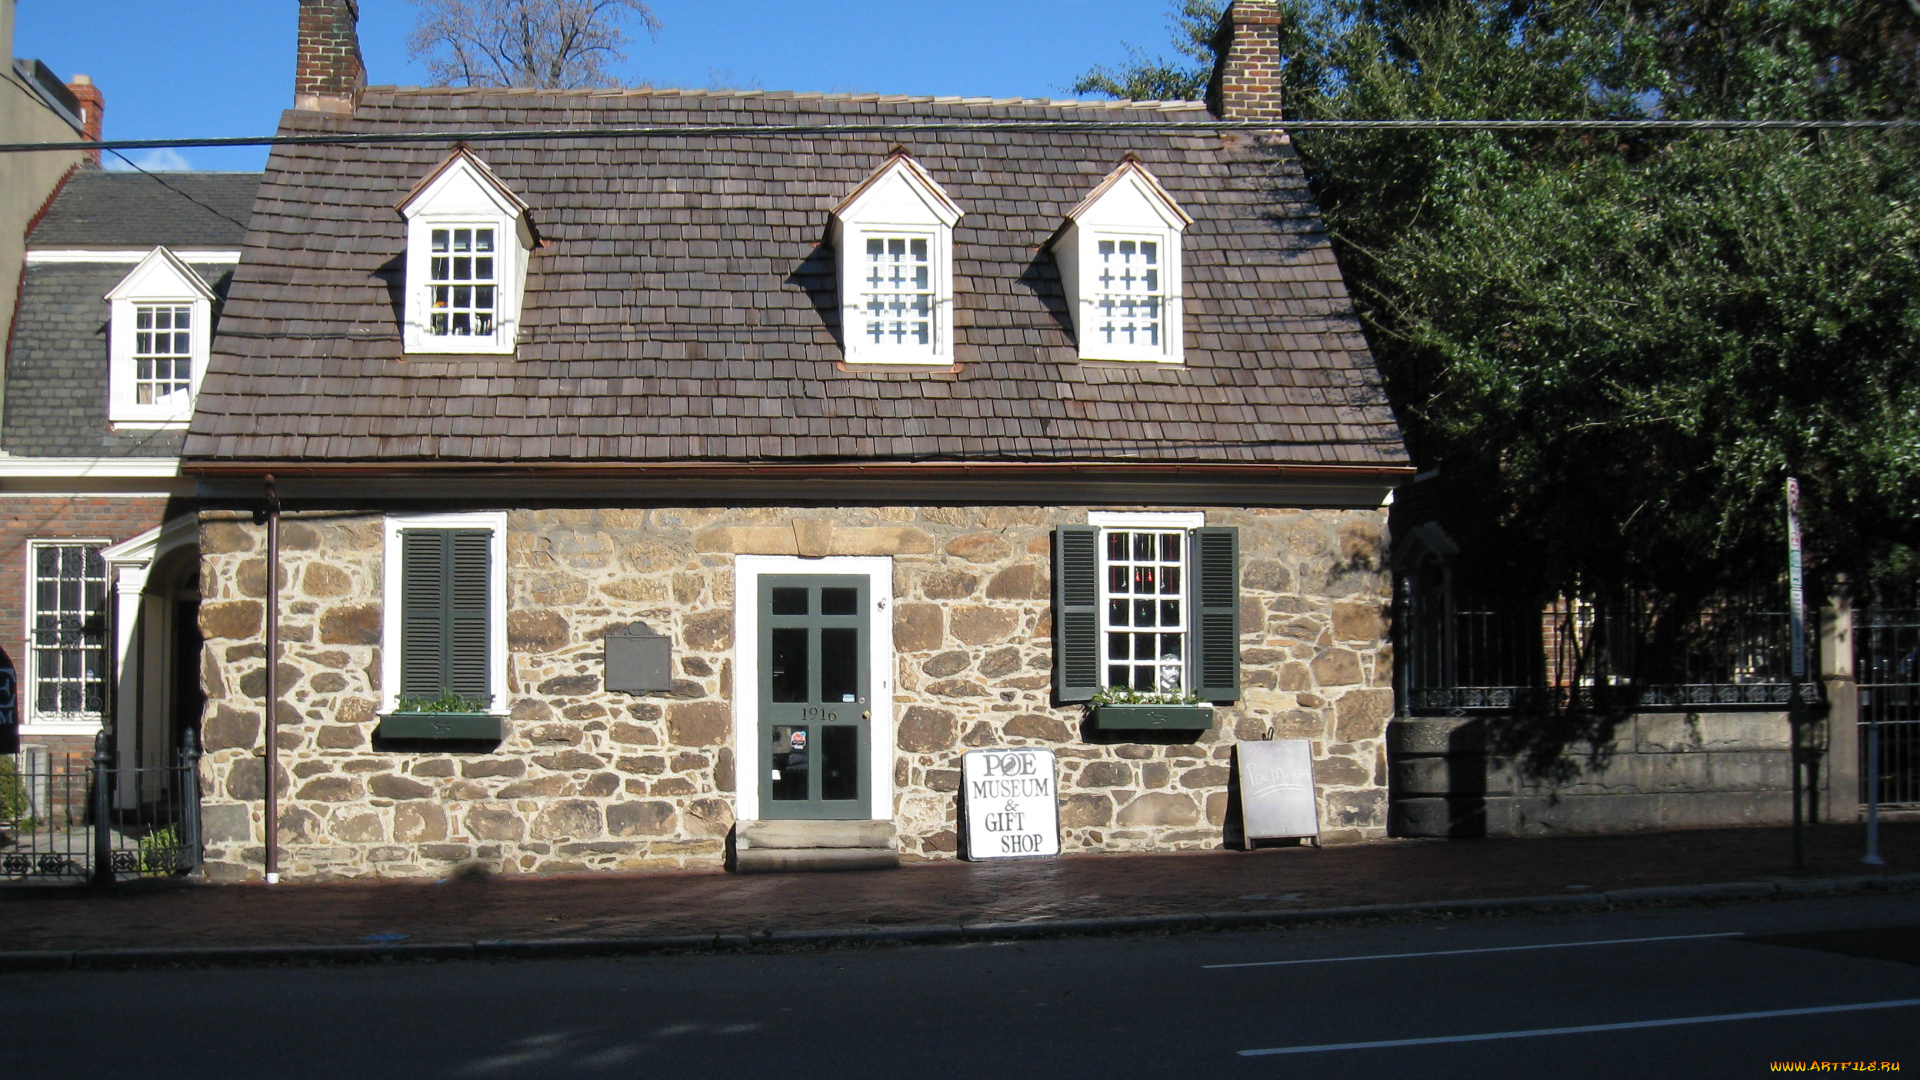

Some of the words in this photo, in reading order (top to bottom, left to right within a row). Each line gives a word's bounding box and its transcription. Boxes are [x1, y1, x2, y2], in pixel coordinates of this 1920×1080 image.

[801, 706, 837, 721] 1916
[983, 753, 1037, 777] POE
[973, 778, 1050, 799] MUSEUM
[1004, 799, 1020, 812] &
[985, 812, 1026, 832] GIFT
[1001, 834, 1043, 853] SHOP
